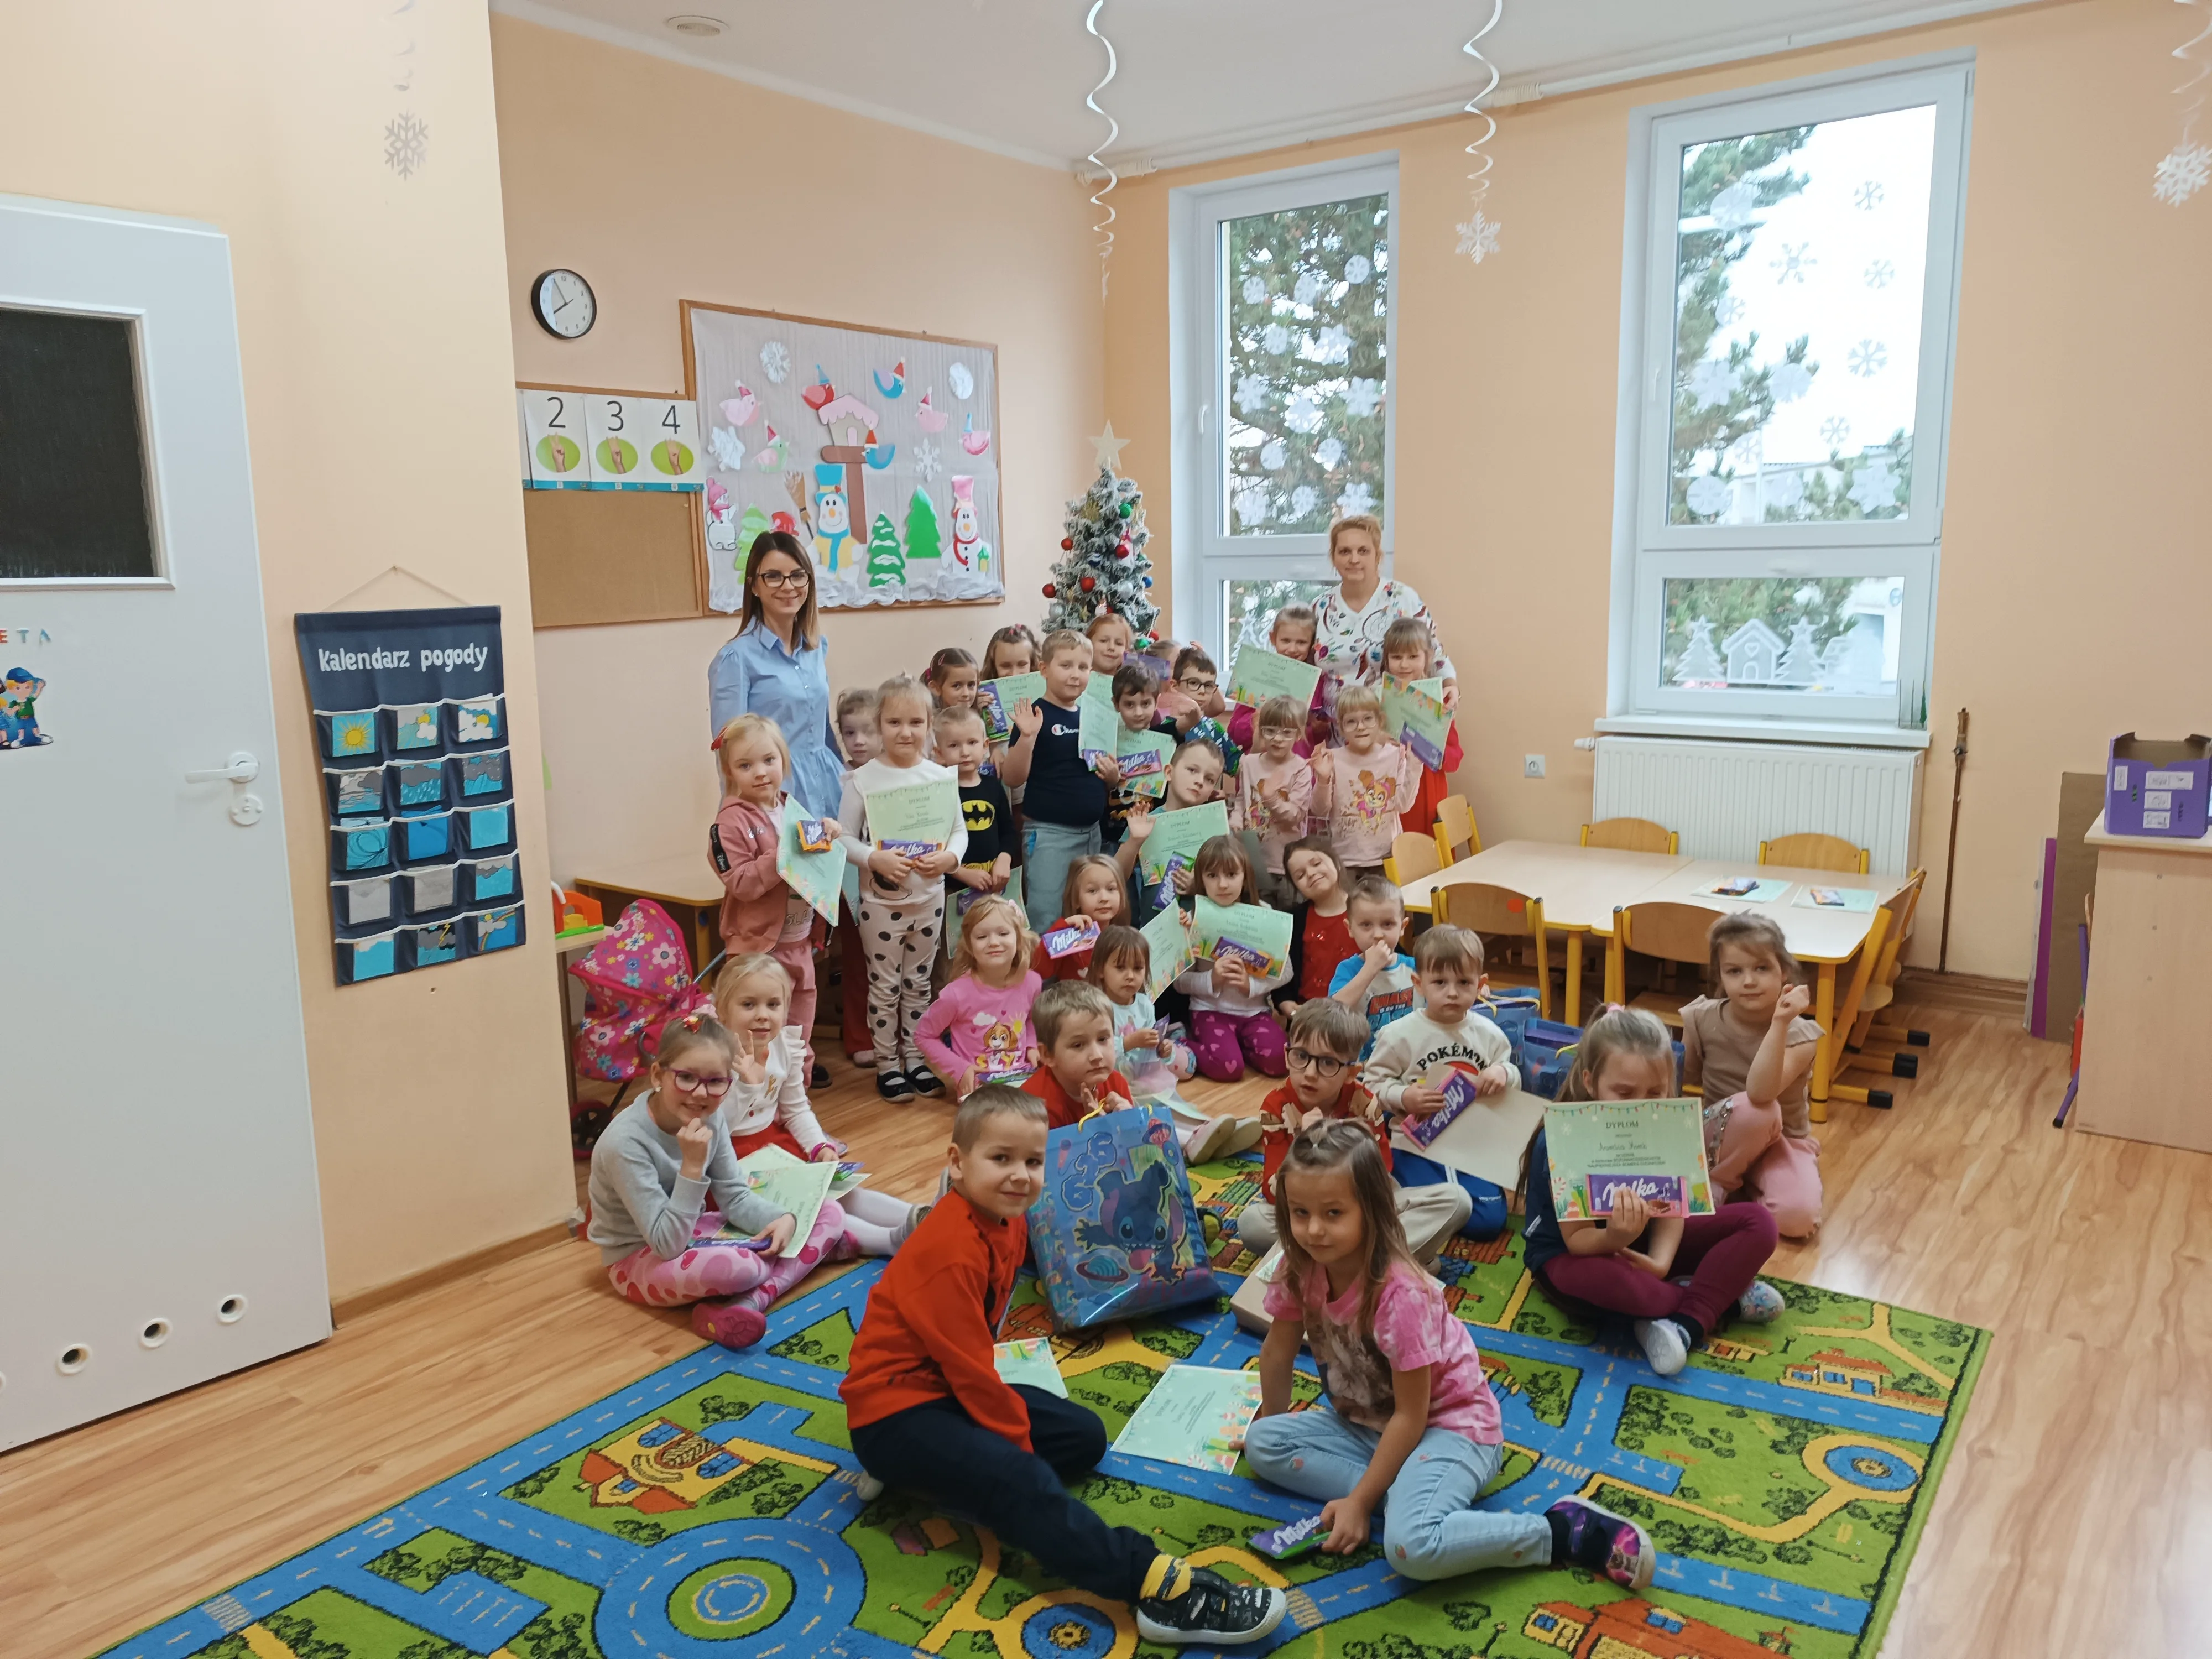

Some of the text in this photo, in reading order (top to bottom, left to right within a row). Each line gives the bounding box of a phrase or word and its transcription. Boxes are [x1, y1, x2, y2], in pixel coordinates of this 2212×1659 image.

[547, 396, 566, 428] 2
[606, 400, 624, 431] 3
[661, 405, 681, 434] 4
[420, 642, 488, 672] pogody
[1120, 754, 1146, 774] Milka
[1417, 1041, 1488, 1071] POKÉMON
[1606, 1120, 1639, 1129] DYPLOM
[1602, 1177, 1658, 1208] Mlka
[1273, 1515, 1321, 1545] Milka
